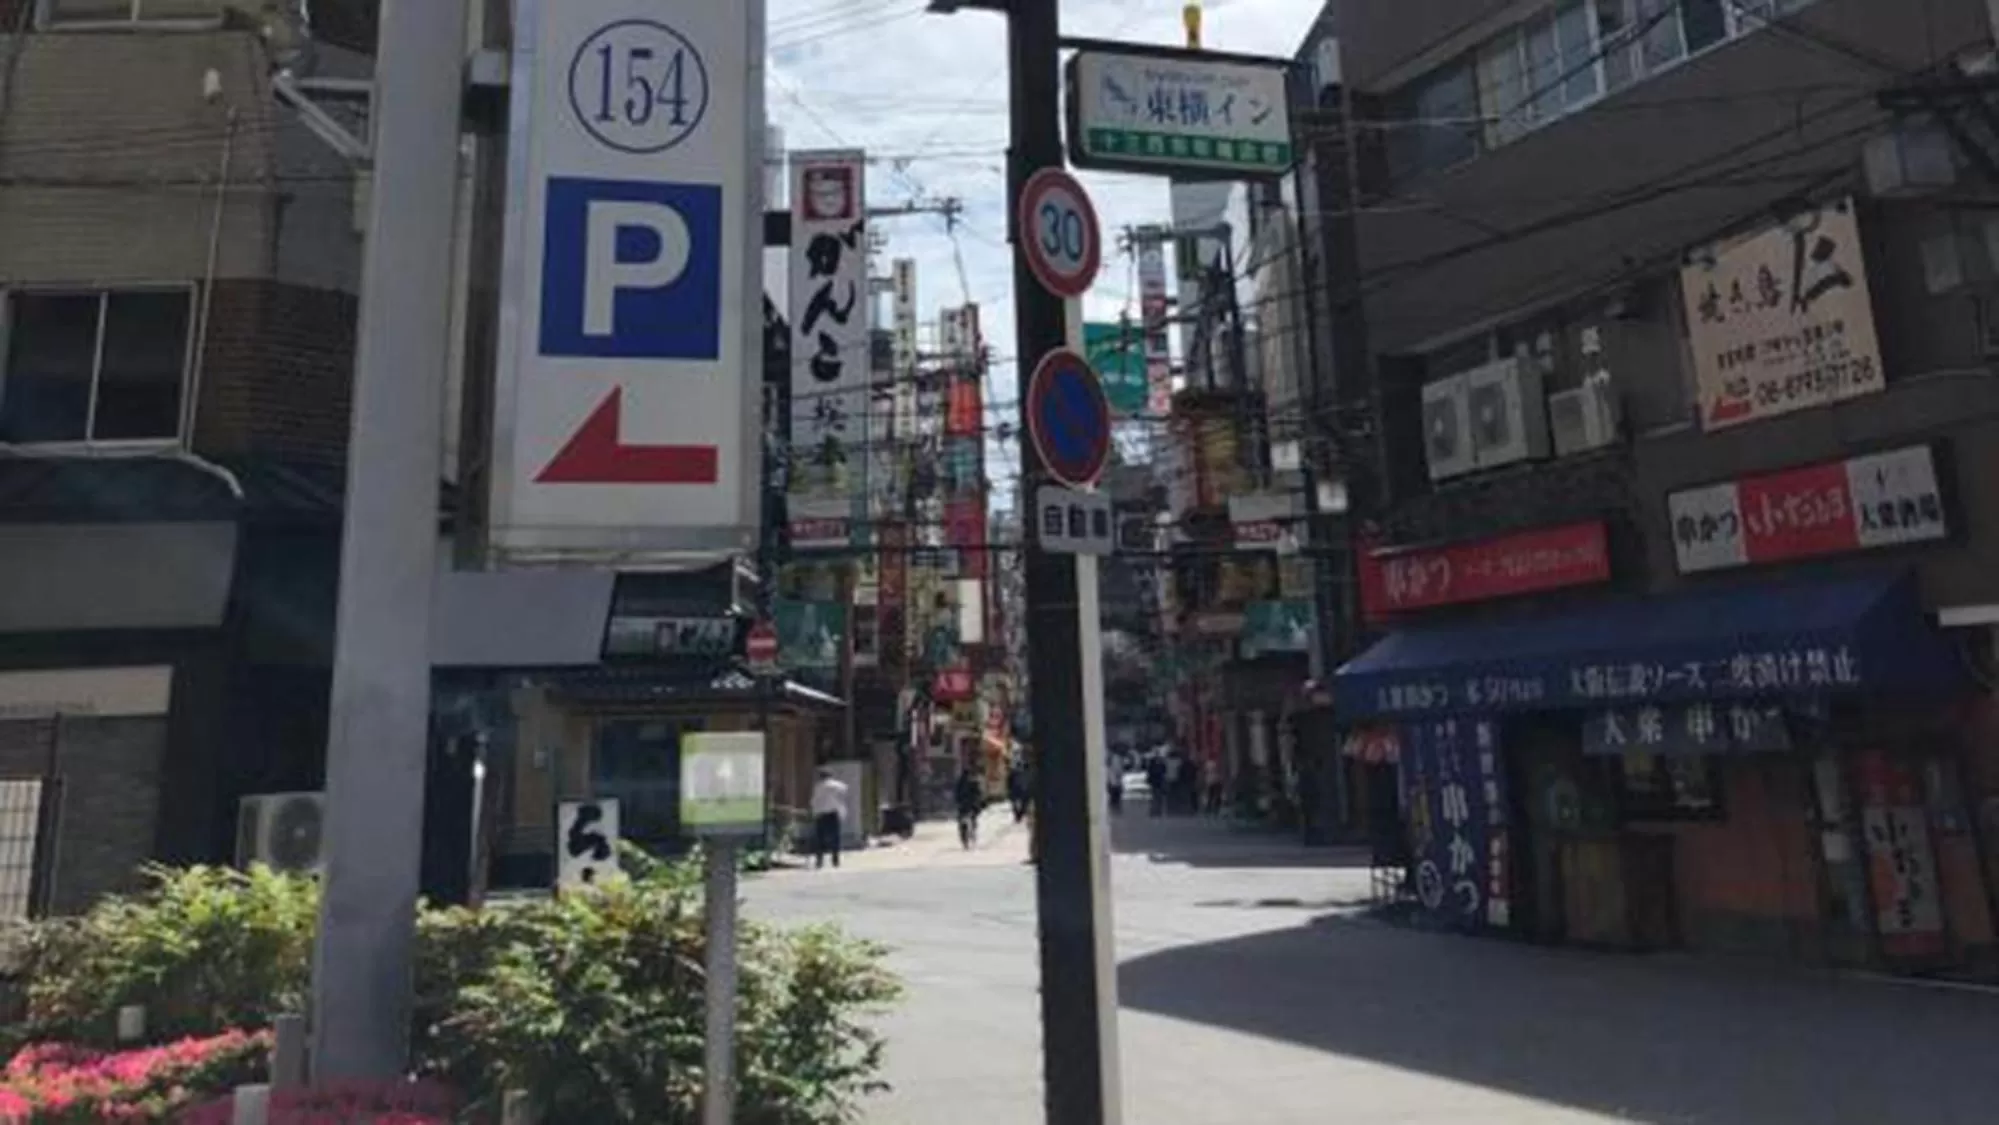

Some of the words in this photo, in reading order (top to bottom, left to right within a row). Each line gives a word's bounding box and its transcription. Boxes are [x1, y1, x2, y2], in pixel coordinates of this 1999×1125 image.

[594, 42, 689, 126] 154
[583, 200, 691, 336] P
[1040, 203, 1082, 261] 30
[801, 218, 864, 382] がんこ
[567, 804, 612, 882] ら
